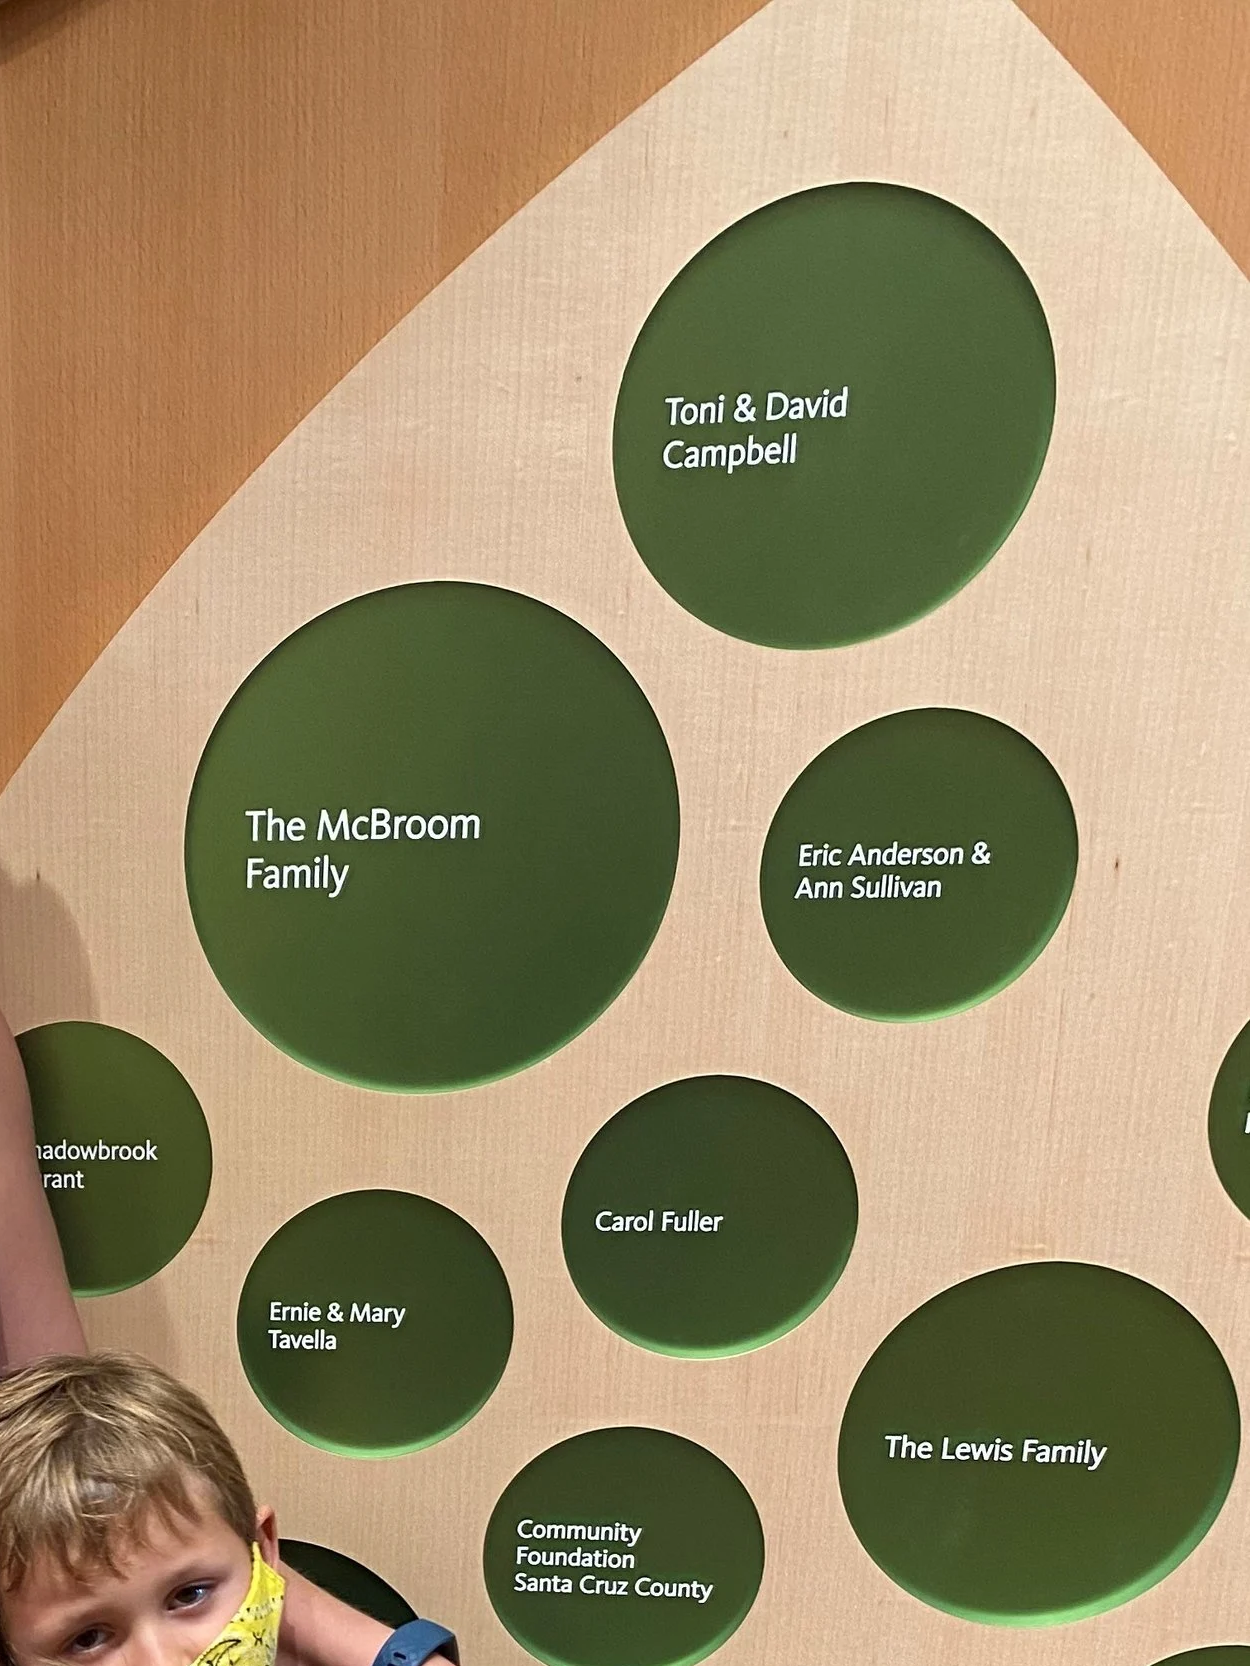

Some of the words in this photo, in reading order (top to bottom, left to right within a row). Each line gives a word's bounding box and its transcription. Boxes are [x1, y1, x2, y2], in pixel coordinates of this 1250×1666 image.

[664, 394, 726, 426] Toni
[733, 393, 757, 423] &
[765, 385, 849, 421] David
[662, 432, 797, 475] Campbell
[245, 807, 306, 842] The
[316, 807, 481, 841] McBroom
[798, 843, 843, 867] Eric
[847, 841, 964, 866] Anderson
[971, 841, 991, 865] &
[246, 854, 350, 898] Family
[794, 876, 844, 899] Ann
[850, 873, 942, 899] Sullivan
[35, 1139, 158, 1161] adowbrook
[595, 1209, 654, 1232] Carol
[661, 1209, 724, 1232] Fuller
[269, 1301, 322, 1322] Ernie
[326, 1302, 344, 1323] &
[349, 1302, 406, 1329] Mary
[267, 1328, 337, 1351] Tavella
[884, 1434, 934, 1460] The
[941, 1437, 1014, 1462] Lewis
[1022, 1439, 1108, 1471] Family
[517, 1519, 643, 1548] Community
[516, 1546, 636, 1569] Foundation
[513, 1572, 573, 1593] Santa
[579, 1574, 629, 1596] Cruz
[634, 1577, 714, 1604] County
